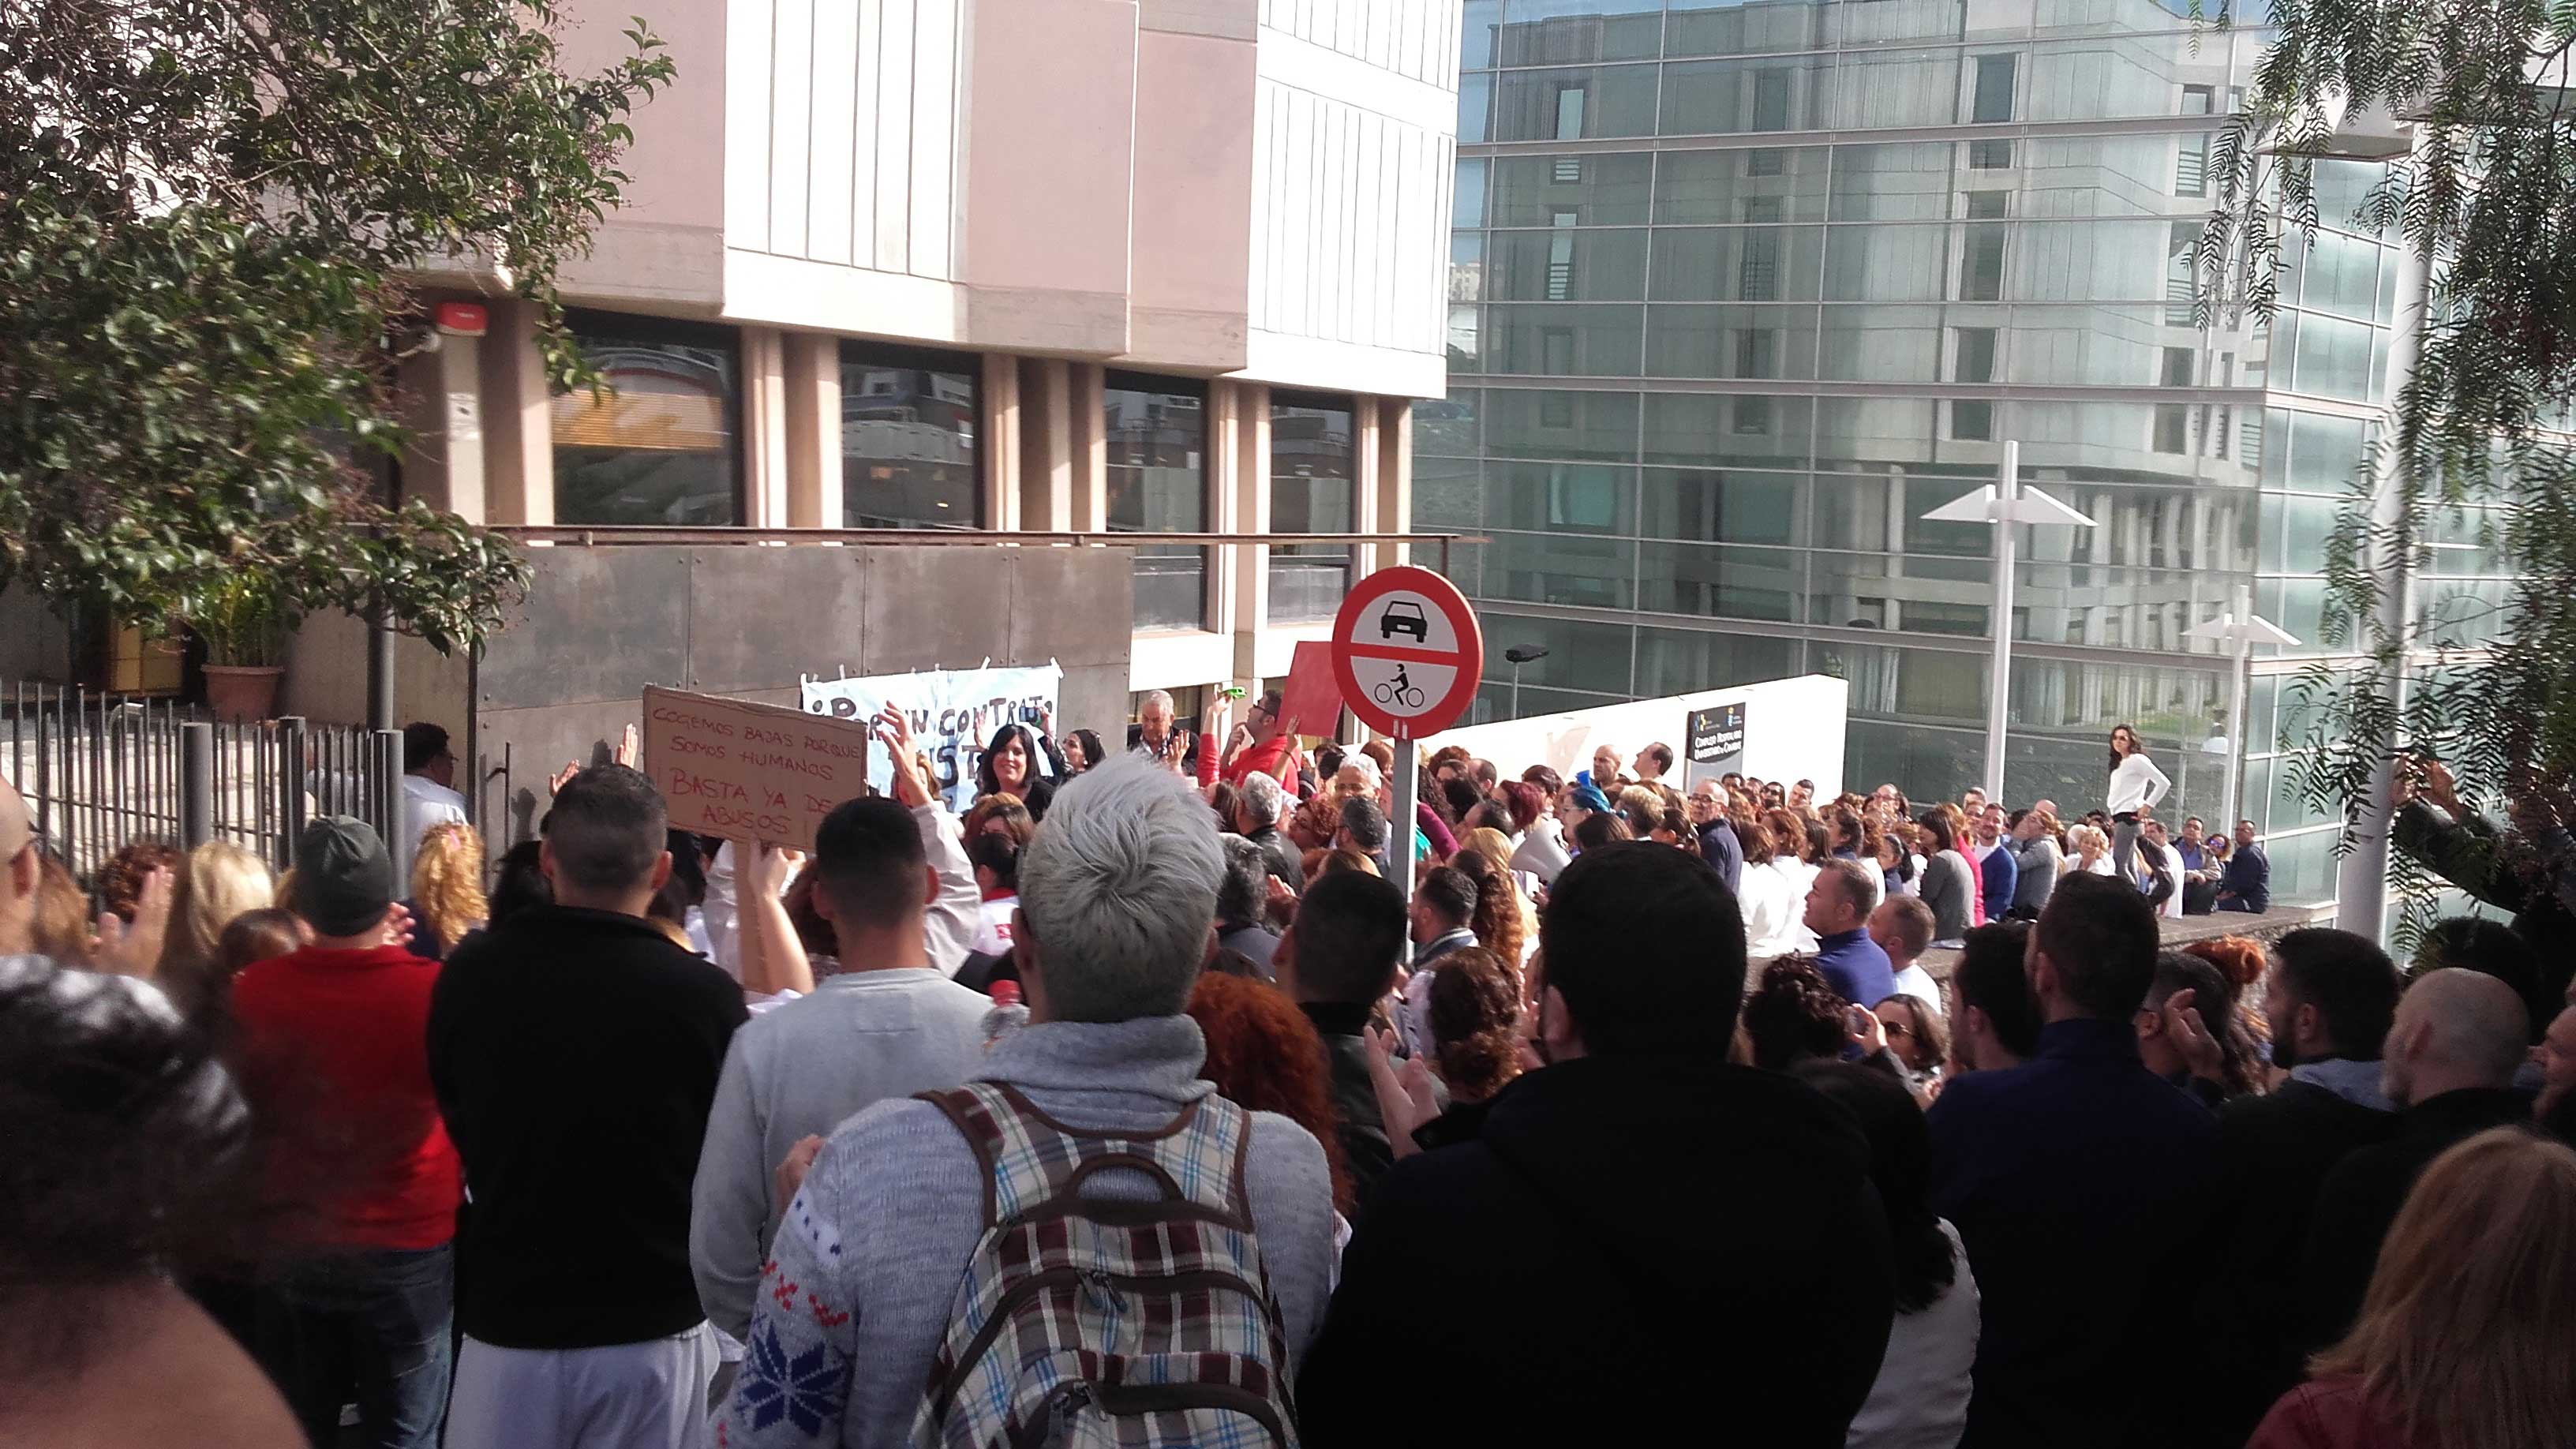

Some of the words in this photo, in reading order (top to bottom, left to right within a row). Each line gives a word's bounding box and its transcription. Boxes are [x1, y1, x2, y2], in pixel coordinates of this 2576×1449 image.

[653, 707, 733, 736] COGEMOS
[744, 726, 793, 747] BAJAS
[804, 735, 860, 759] PORQUE
[669, 735, 725, 758] SOMOS
[739, 750, 833, 781] HUMANOS
[702, 803, 792, 834] ABUSOS
[763, 786, 788, 809] YA
[804, 793, 833, 814] DE
